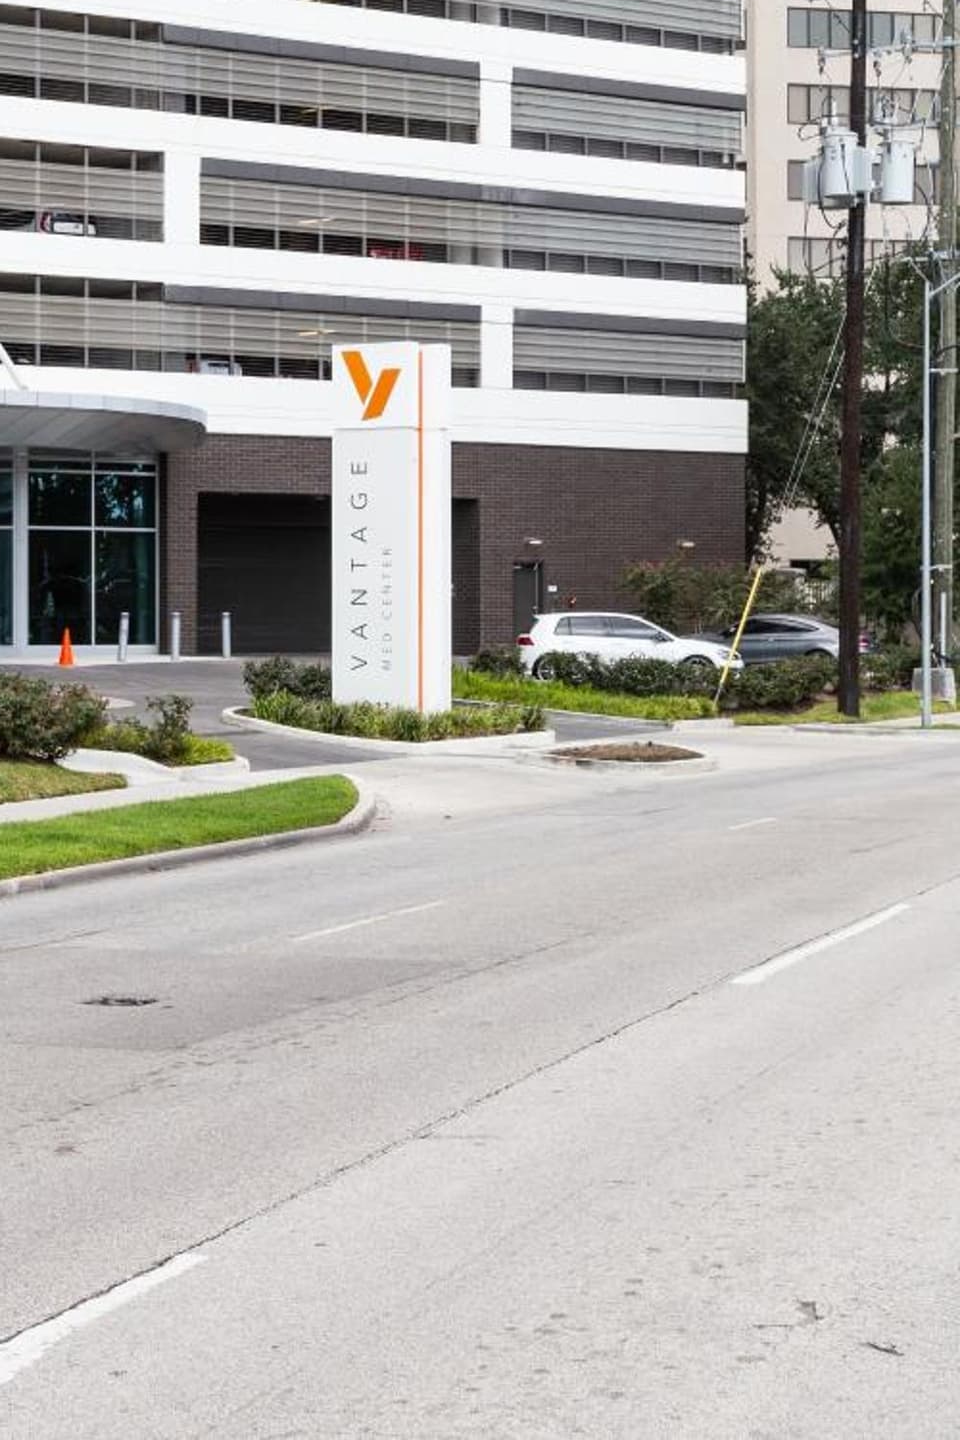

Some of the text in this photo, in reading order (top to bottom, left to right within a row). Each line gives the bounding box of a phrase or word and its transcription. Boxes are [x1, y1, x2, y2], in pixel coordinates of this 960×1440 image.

[350, 462, 369, 670] VANTAGE
[381, 548, 392, 671] MED CENTER
